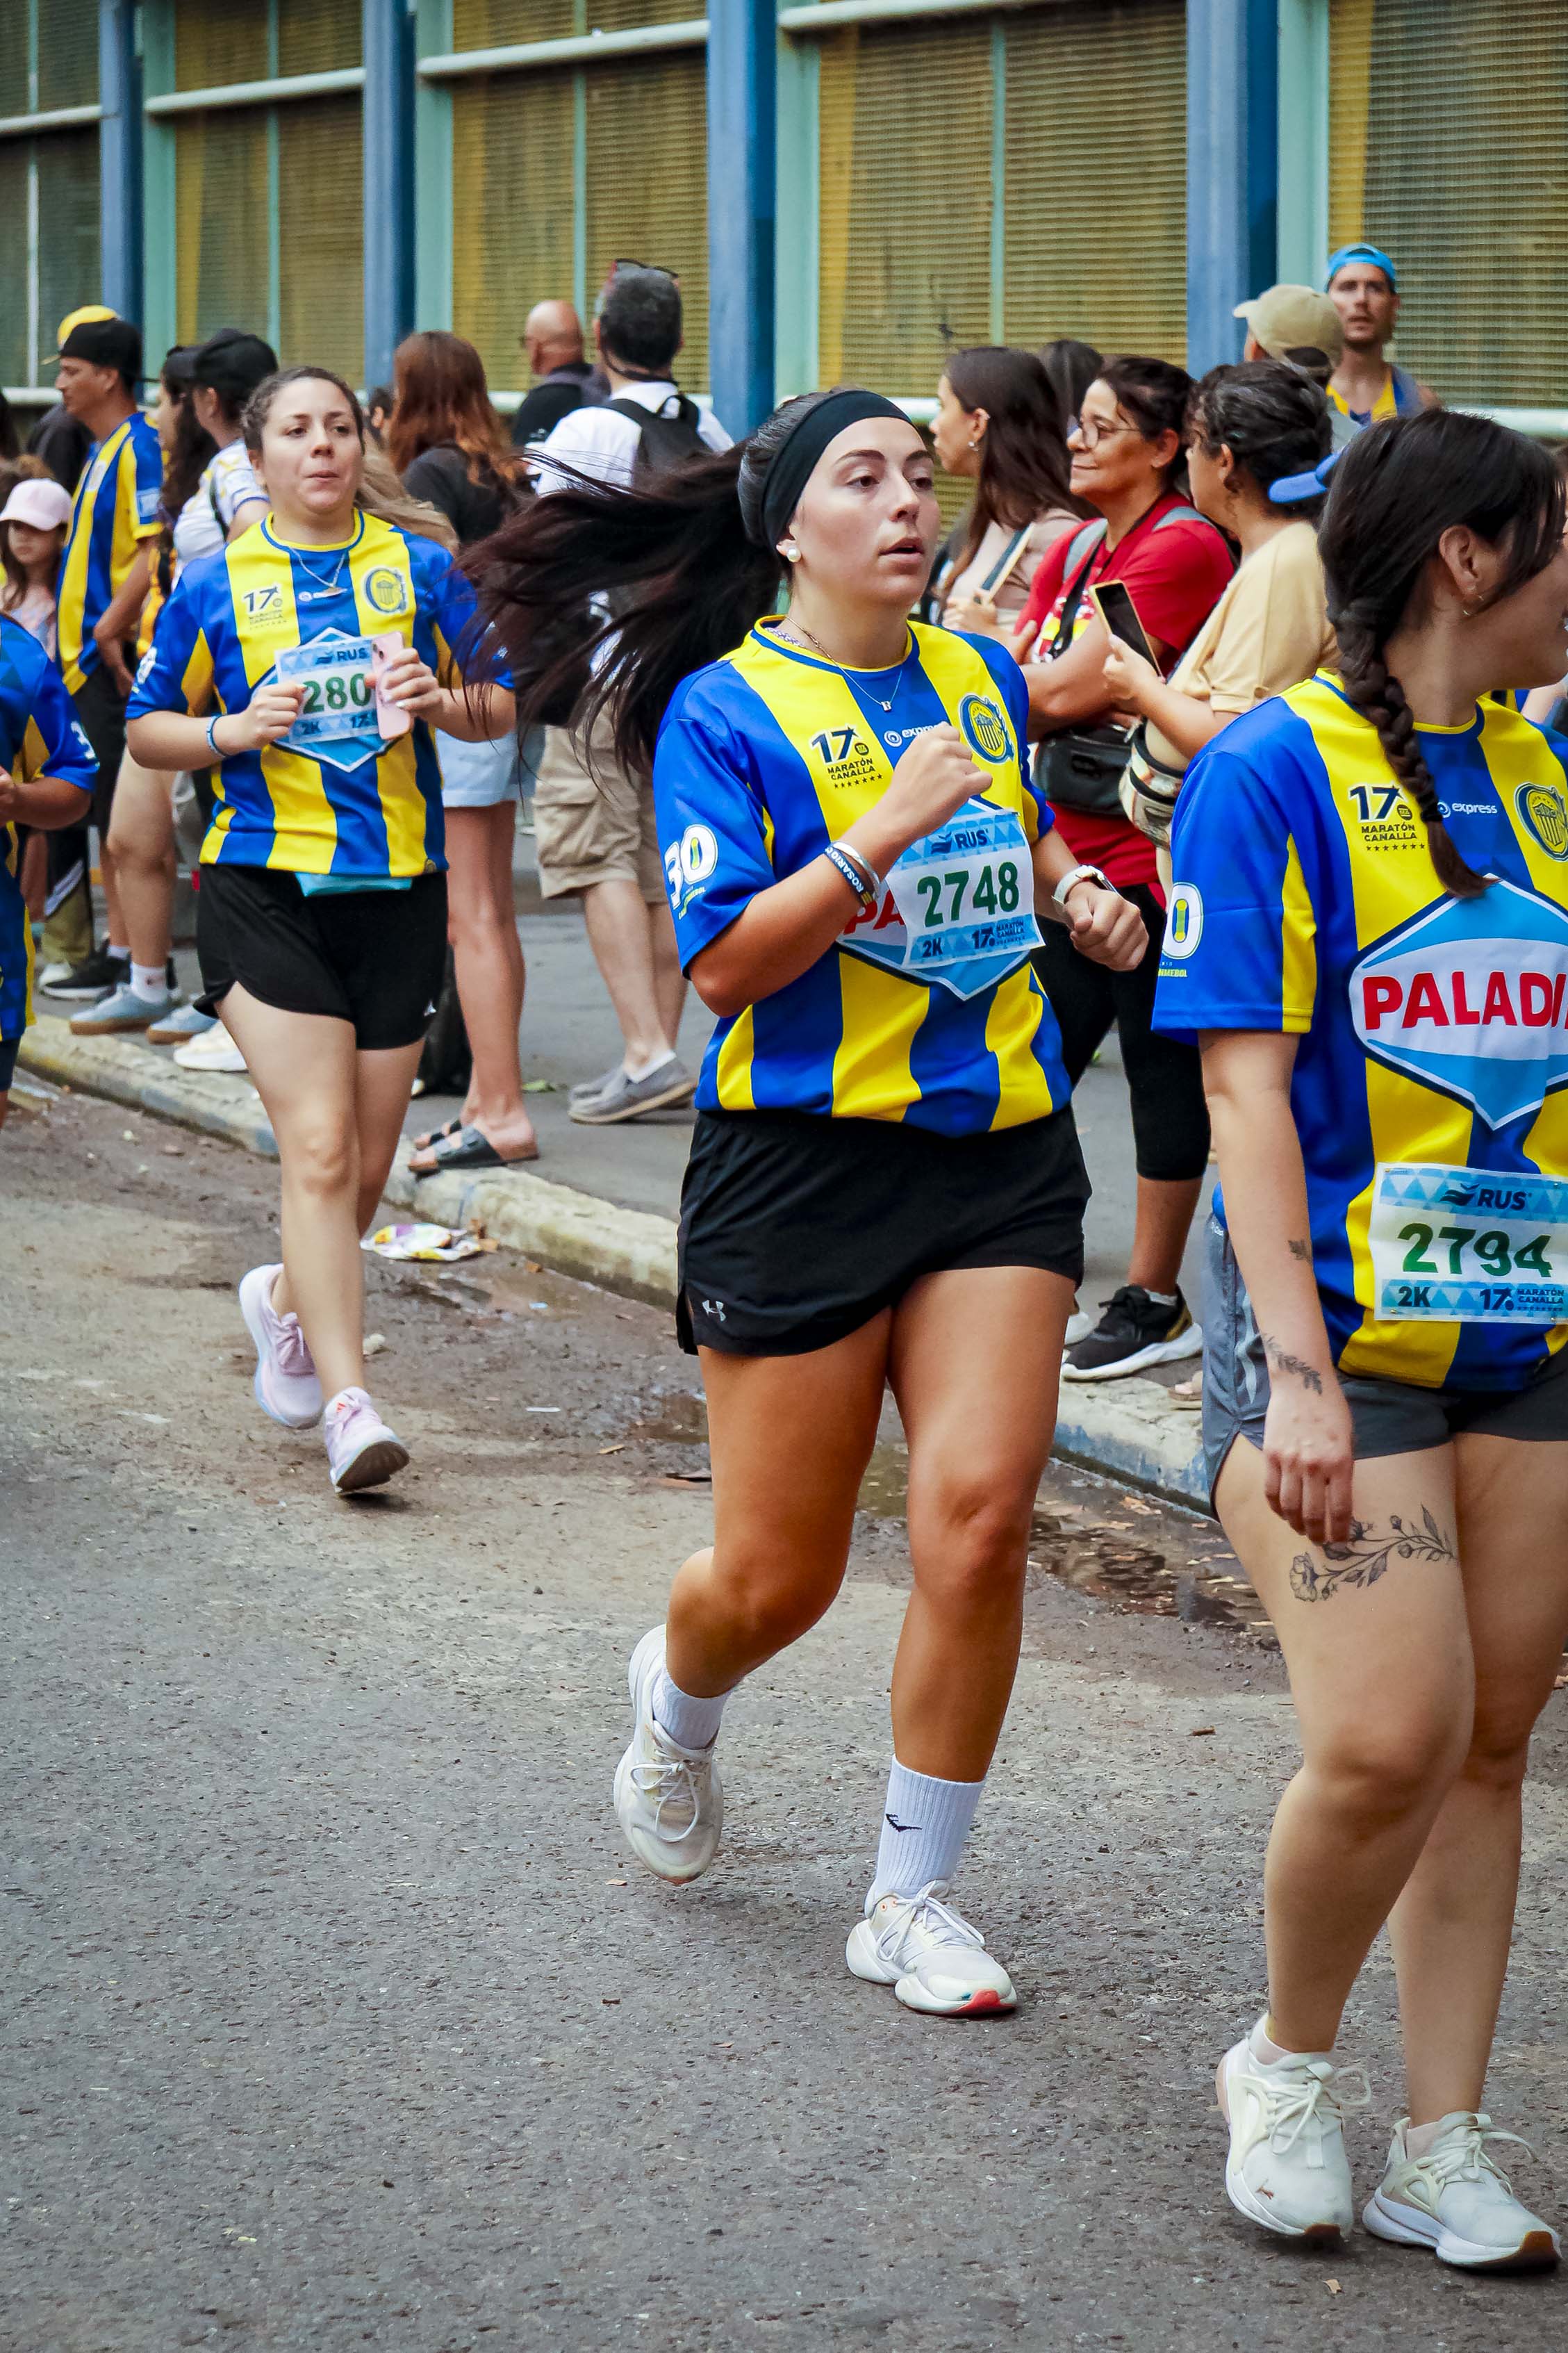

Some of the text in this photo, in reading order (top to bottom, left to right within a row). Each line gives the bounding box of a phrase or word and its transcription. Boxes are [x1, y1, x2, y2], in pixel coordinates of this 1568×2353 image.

[244, 586, 278, 612] 17
[337, 648, 368, 661] RUS
[302, 673, 372, 714] 280
[811, 727, 859, 763] 17
[827, 758, 873, 774] MARATÓN
[831, 766, 875, 780] CANALLA
[1350, 785, 1404, 820] 17
[1452, 803, 1497, 814] express
[1361, 822, 1415, 834] MARATÓN
[1364, 831, 1417, 842] CANALLA
[955, 830, 988, 848] RUS
[664, 824, 718, 910] 30
[831, 851, 864, 892] ROSARIO
[917, 862, 1019, 928] 2748
[1162, 882, 1203, 960] 0
[922, 937, 943, 958] 2K
[1362, 971, 1568, 1030] PALADI
[1478, 1189, 1526, 1211] RUS
[1397, 1223, 1553, 1277] 2794
[1398, 1286, 1431, 1307] 2K
[1517, 1288, 1565, 1296] MARATÓN
[1519, 1296, 1563, 1304] CANALLA
